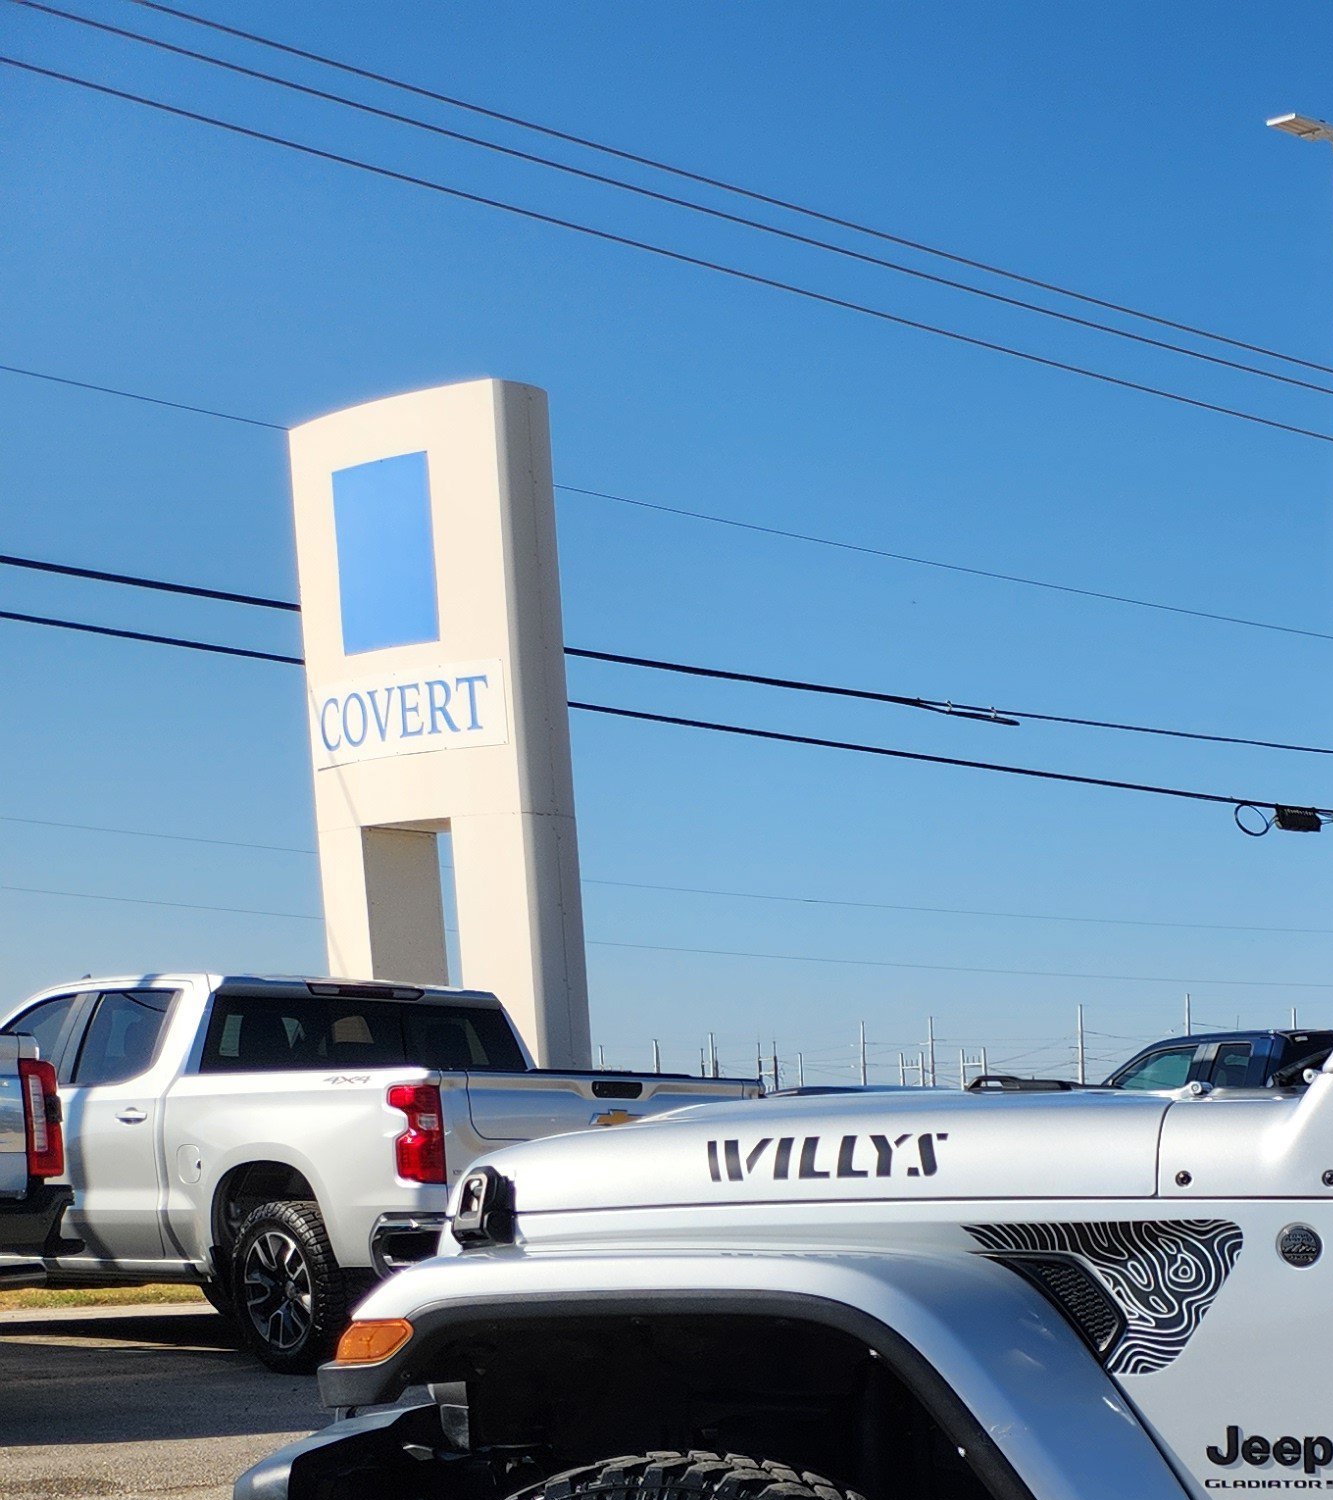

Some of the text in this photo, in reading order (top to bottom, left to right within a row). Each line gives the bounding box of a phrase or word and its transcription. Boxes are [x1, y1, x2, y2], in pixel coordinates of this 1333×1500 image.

[319, 674, 488, 752] COVERT
[707, 1133, 949, 1182] WILLYS
[1206, 1425, 1333, 1474] Jeep
[1204, 1478, 1323, 1489] GLADIATOR
